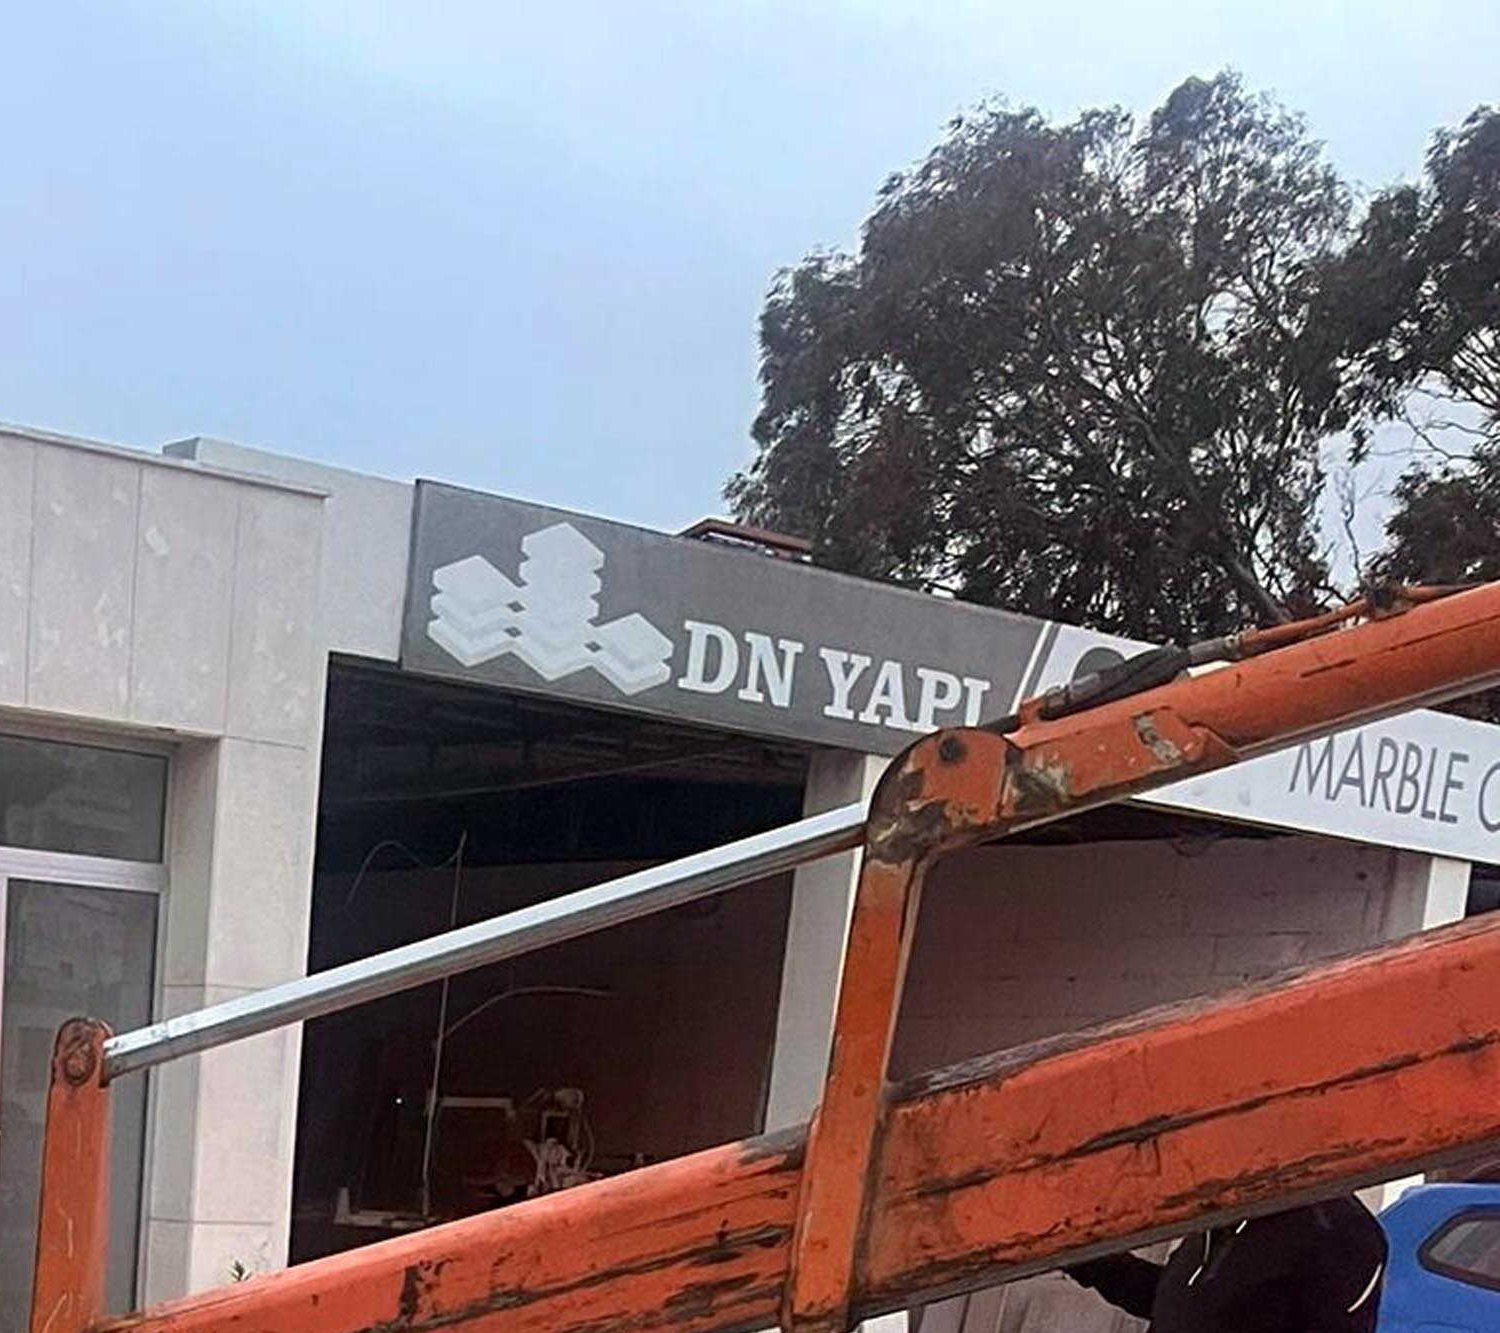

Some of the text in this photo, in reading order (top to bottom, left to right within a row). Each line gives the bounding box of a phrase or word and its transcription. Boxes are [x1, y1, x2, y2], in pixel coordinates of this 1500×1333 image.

[677, 619, 990, 733] DN YAPI
[1288, 731, 1470, 824] MARBLE
